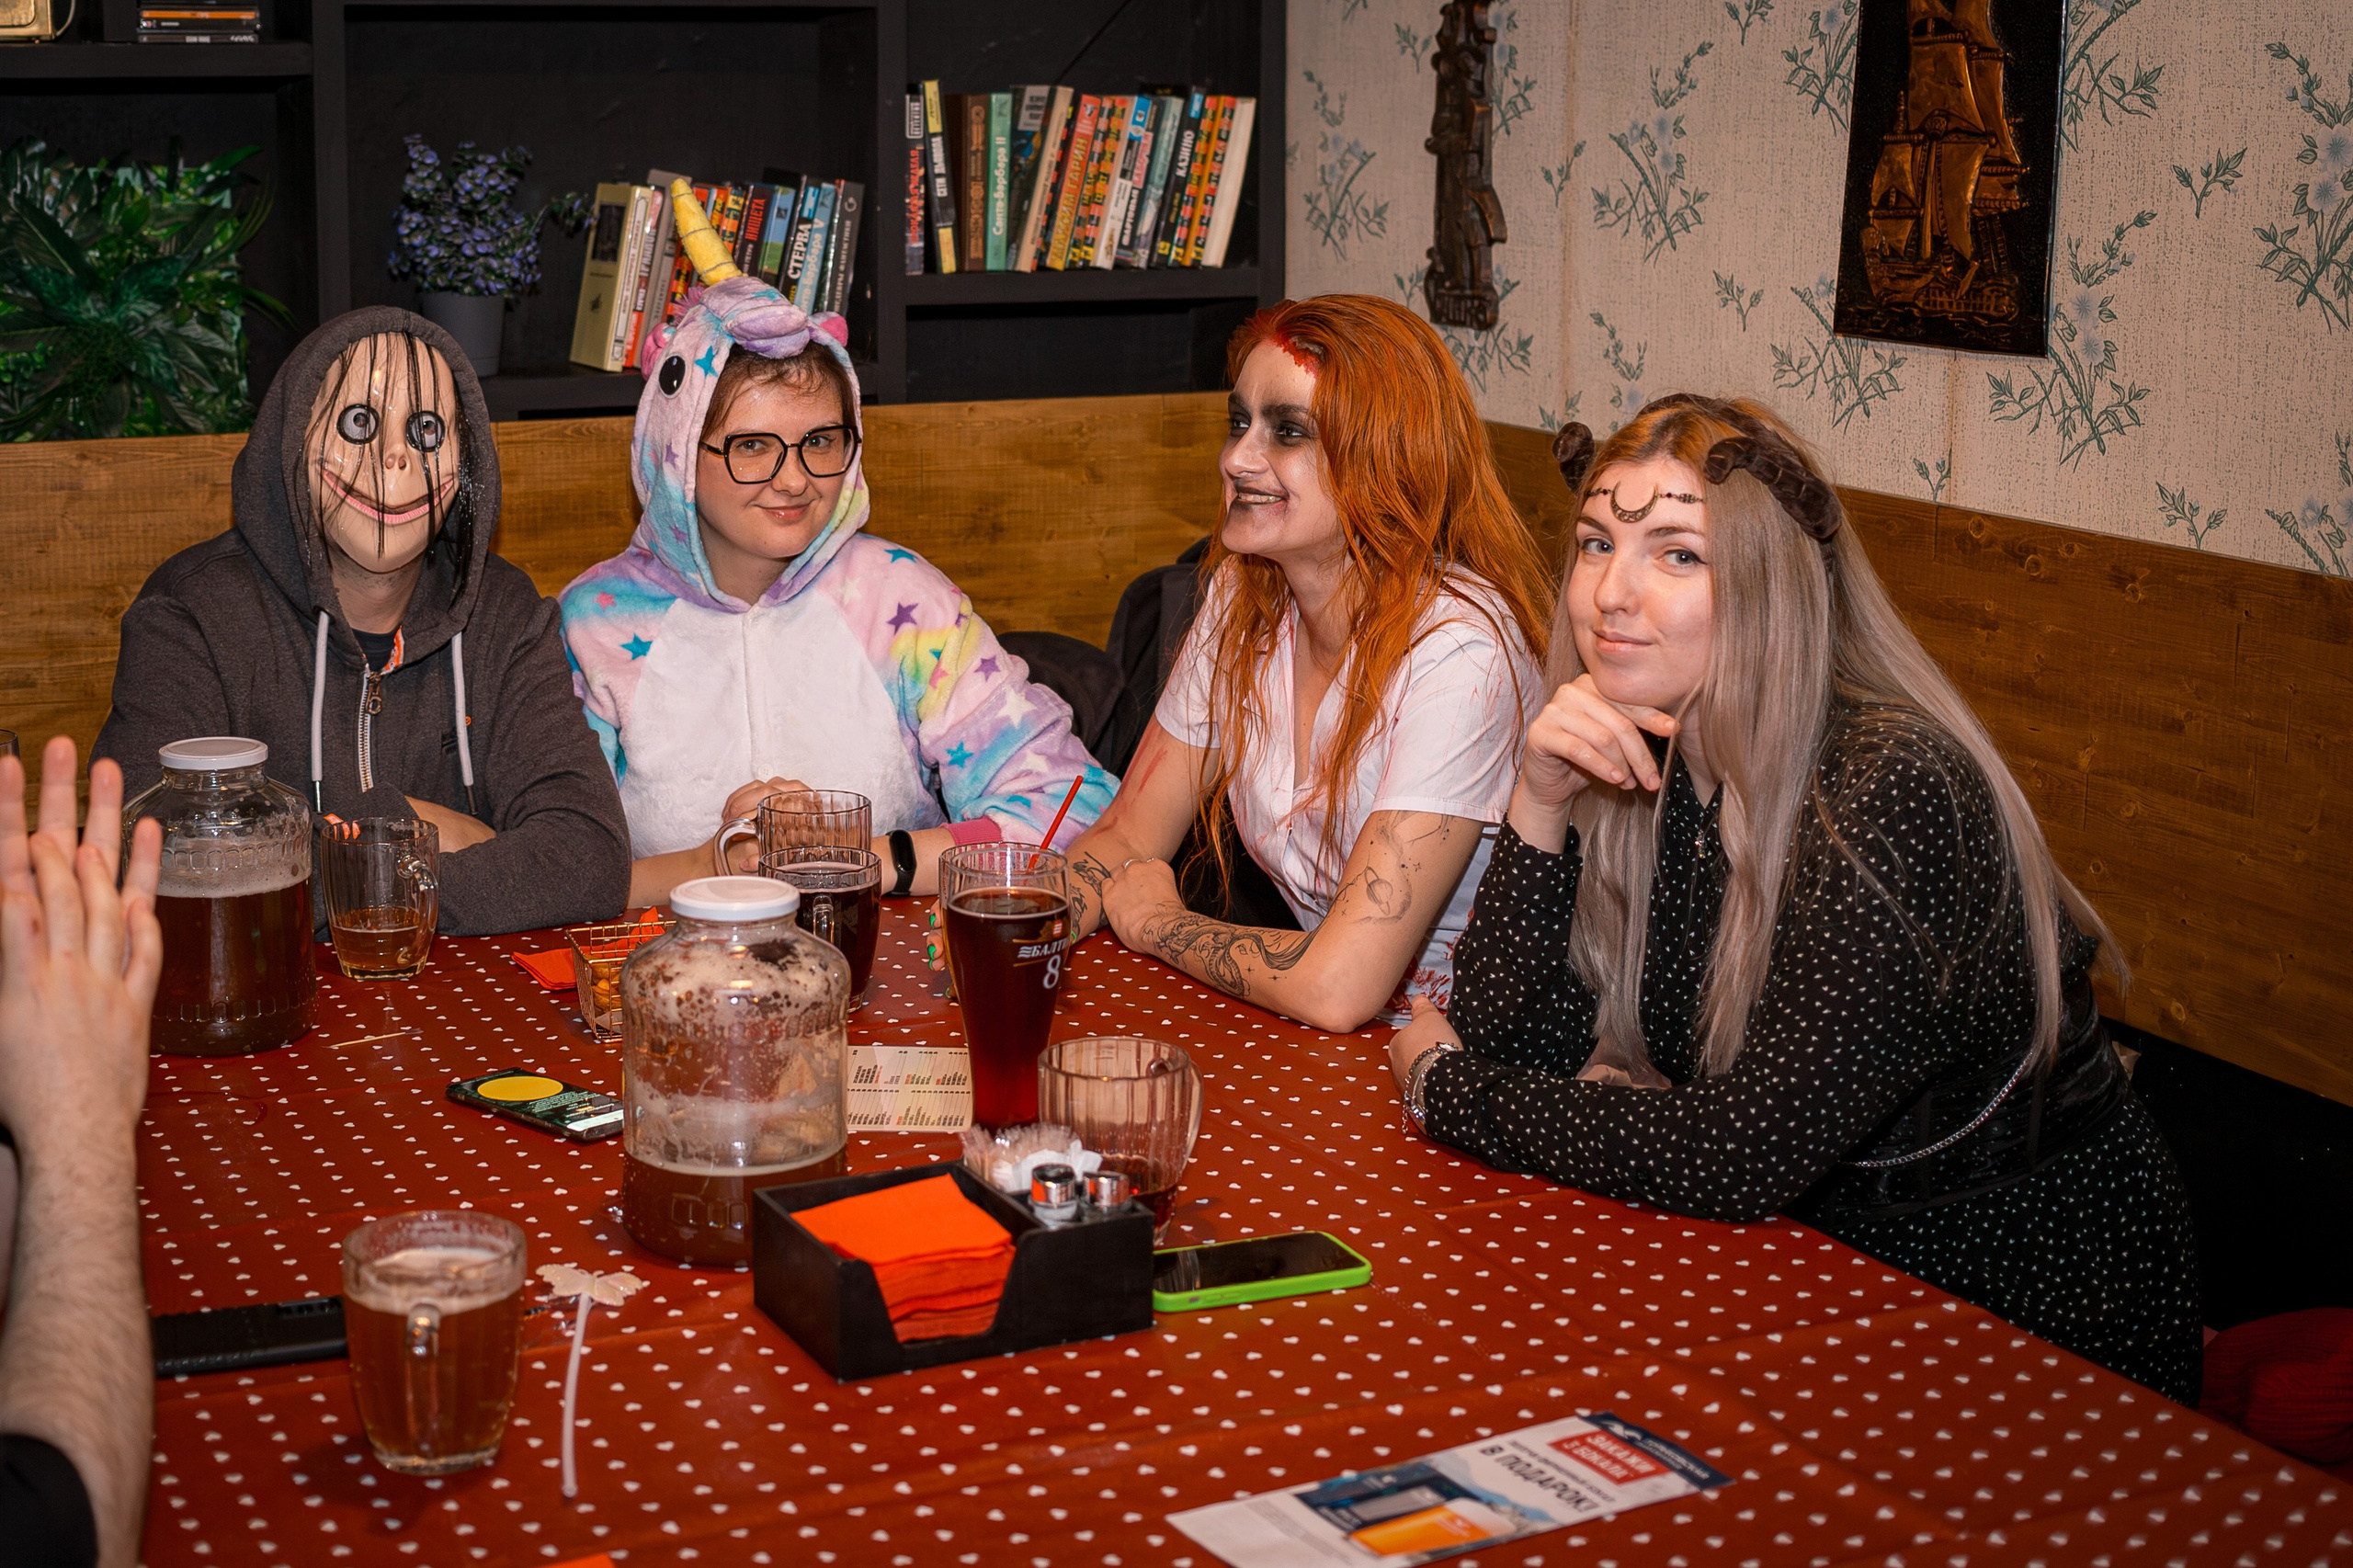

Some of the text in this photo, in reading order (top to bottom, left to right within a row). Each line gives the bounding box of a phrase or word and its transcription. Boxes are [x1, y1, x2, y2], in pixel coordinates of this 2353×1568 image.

[1067, 137, 1088, 189] ГАРИН
[1176, 130, 1195, 177] КАЗИНО
[935, 177, 948, 198] СЕТИ
[745, 199, 766, 241] НИЩЕТА
[788, 223, 812, 279] СТЕРВА
[801, 233, 823, 314] нта-Барбара
[813, 218, 825, 229] V
[1031, 937, 1070, 958] БАЛТИ
[1042, 954, 1061, 989] 8
[1585, 1434, 1656, 1473] ЗАКАЖИ
[1479, 1444, 1505, 1456] В
[1494, 1453, 1601, 1512] ПОДАРОК!
